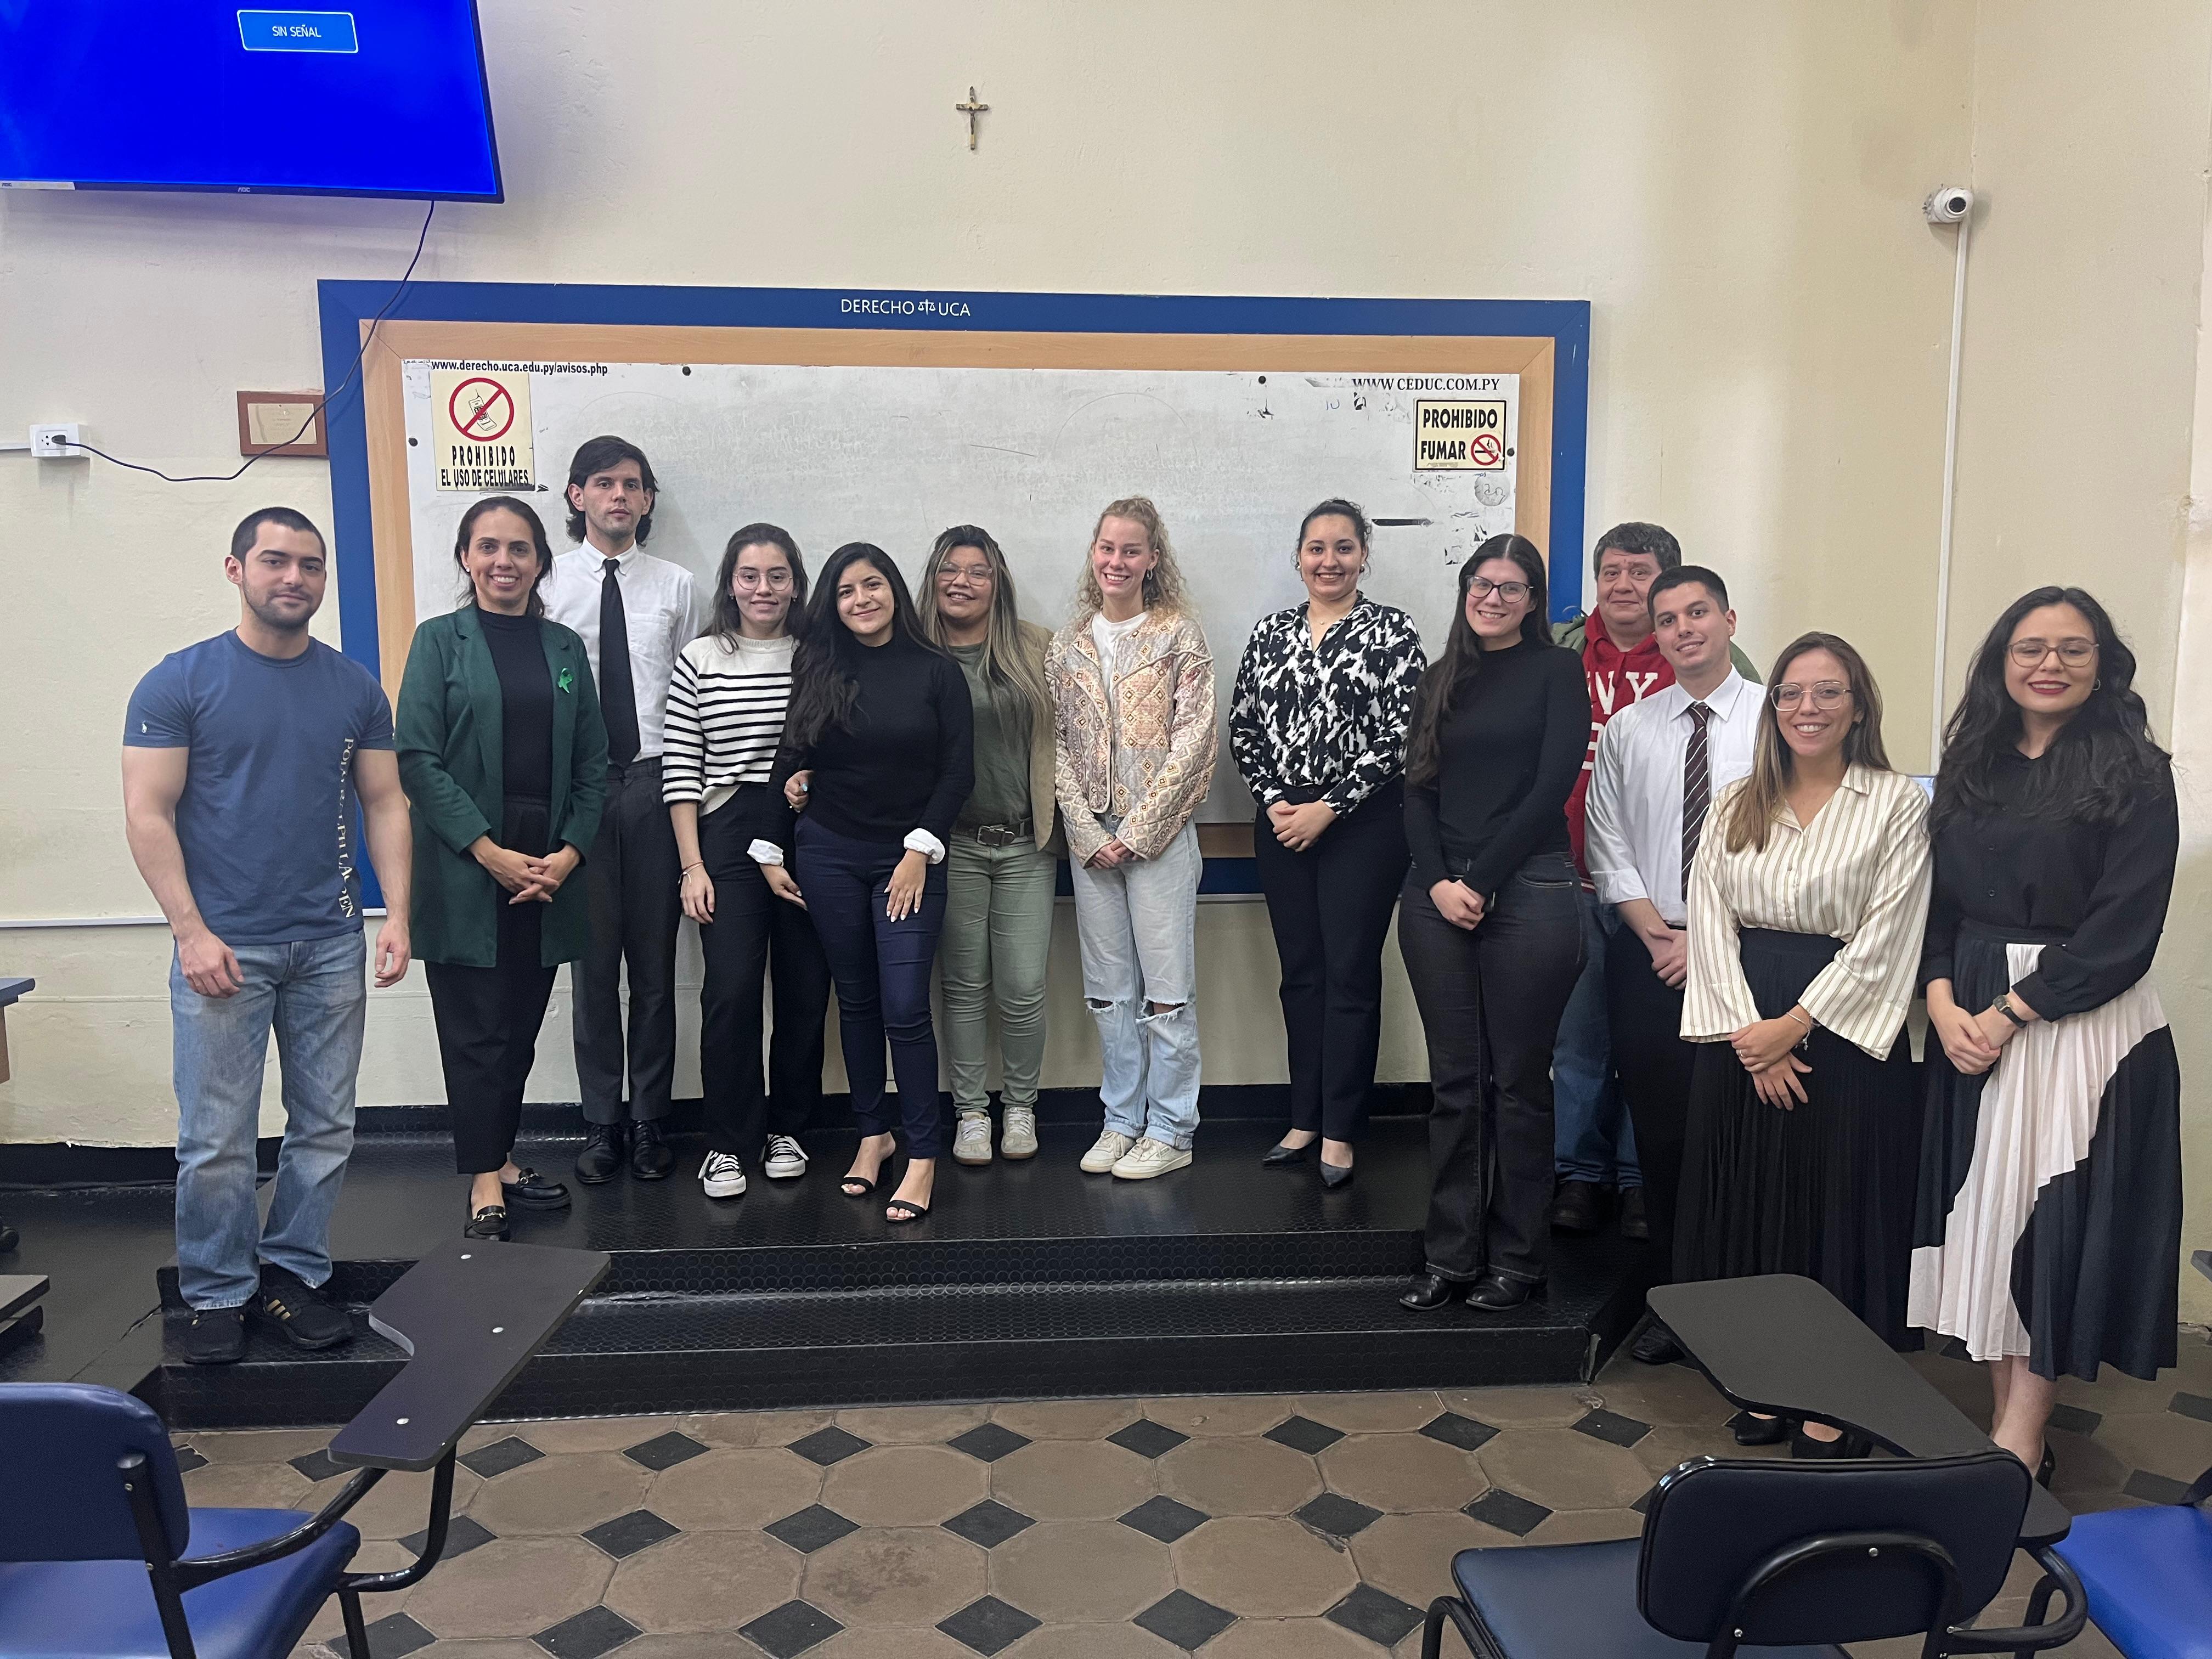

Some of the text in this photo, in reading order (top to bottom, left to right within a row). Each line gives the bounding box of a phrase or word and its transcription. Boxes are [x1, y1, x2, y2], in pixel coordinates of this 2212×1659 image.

[272, 24, 321, 38] SIN SEÑAL
[841, 298, 970, 317] DERECHO UCA
[431, 359, 608, 376] www.derecho.uca.edu.py/avisos.php
[1397, 377, 1500, 391] CEDUC.COM.PY
[1423, 408, 1498, 428] PROHIBIDO
[452, 445, 515, 466] PROHIBIDO
[1420, 441, 1466, 460] FUMAR
[441, 469, 529, 487] EL USO DE CELULARES
[337, 789, 346, 849] RPH
